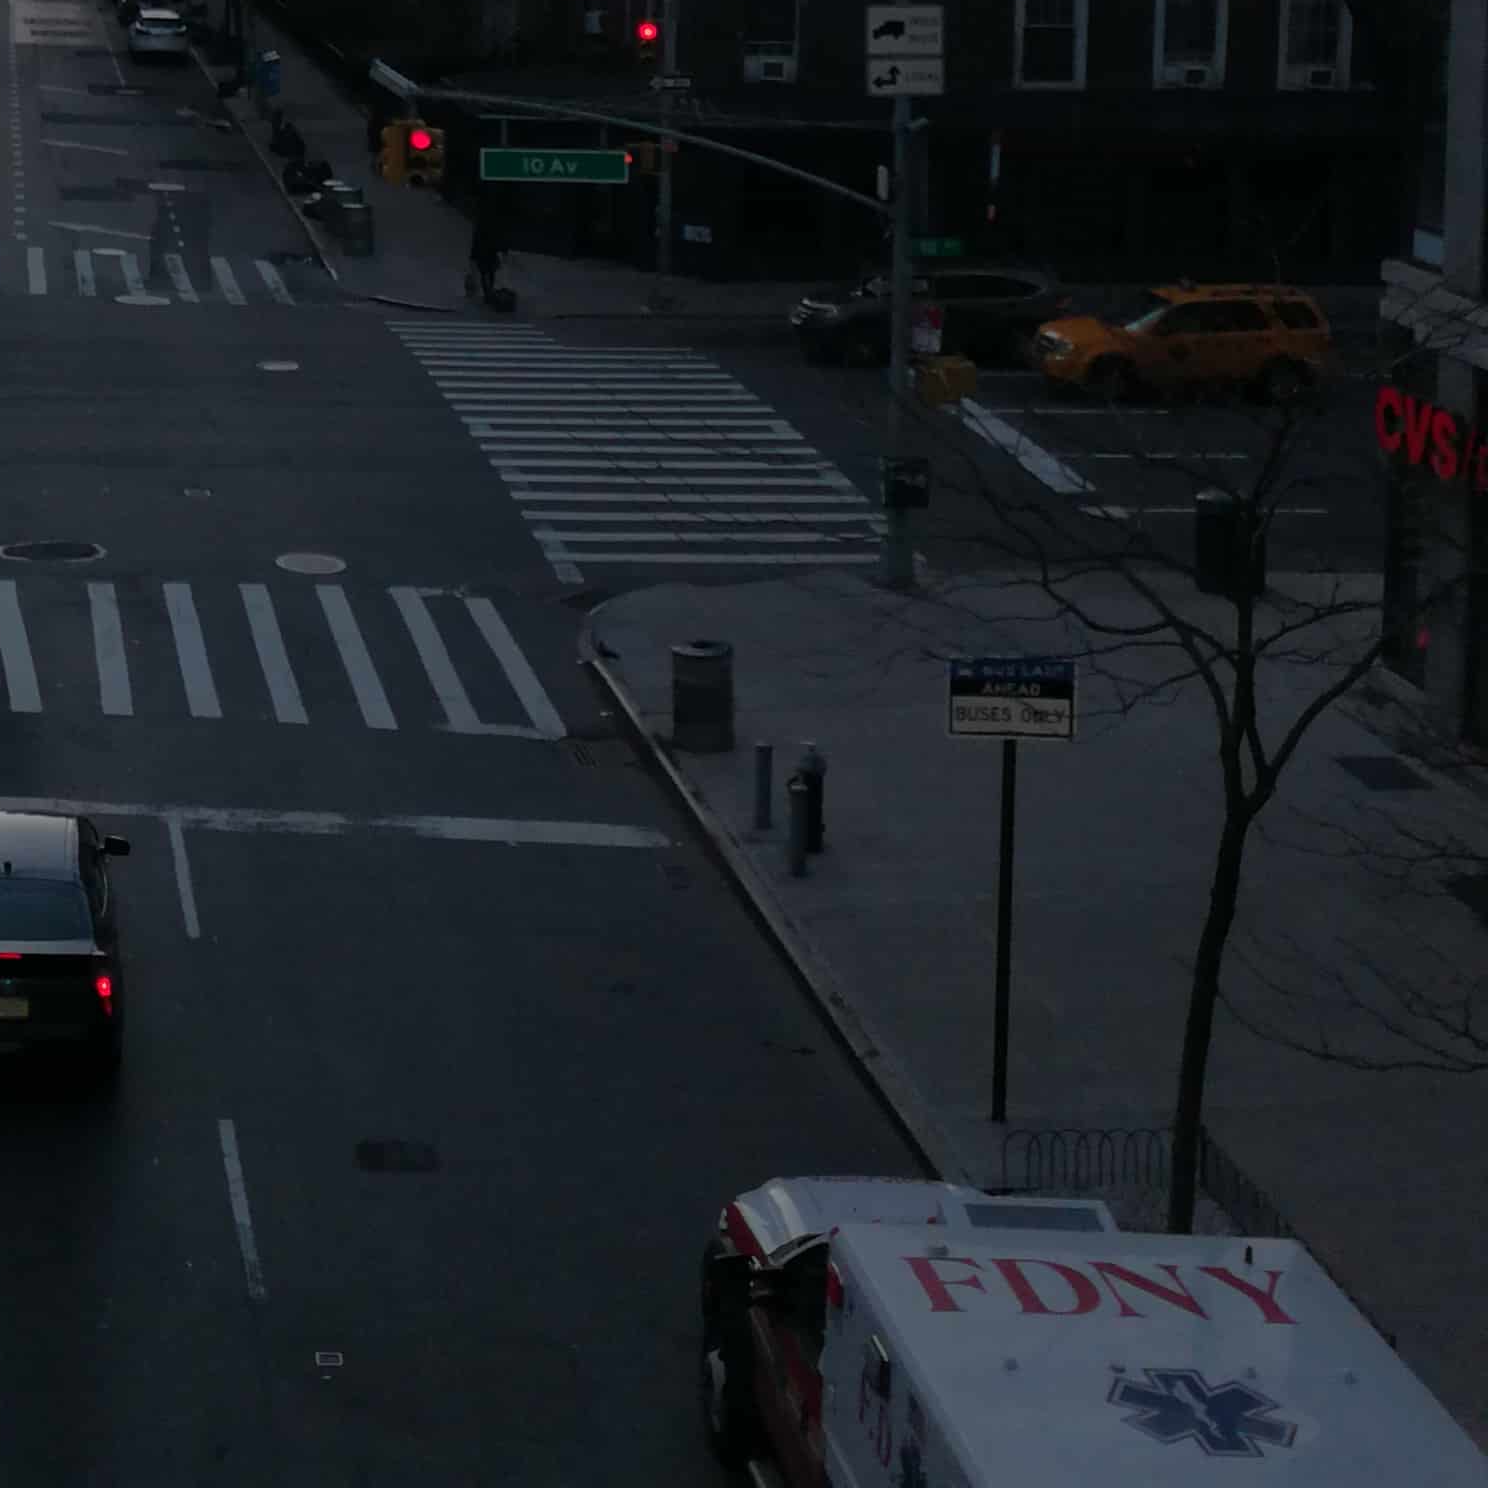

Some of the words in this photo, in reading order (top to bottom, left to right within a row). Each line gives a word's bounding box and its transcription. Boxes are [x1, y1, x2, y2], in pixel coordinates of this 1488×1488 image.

[522, 155, 545, 176] 10
[547, 154, 578, 177] Av
[981, 680, 1041, 697] AHEAD
[957, 707, 1011, 722] BUSES
[1020, 707, 1065, 725] ONLY
[900, 1256, 1297, 1325] FDNY
